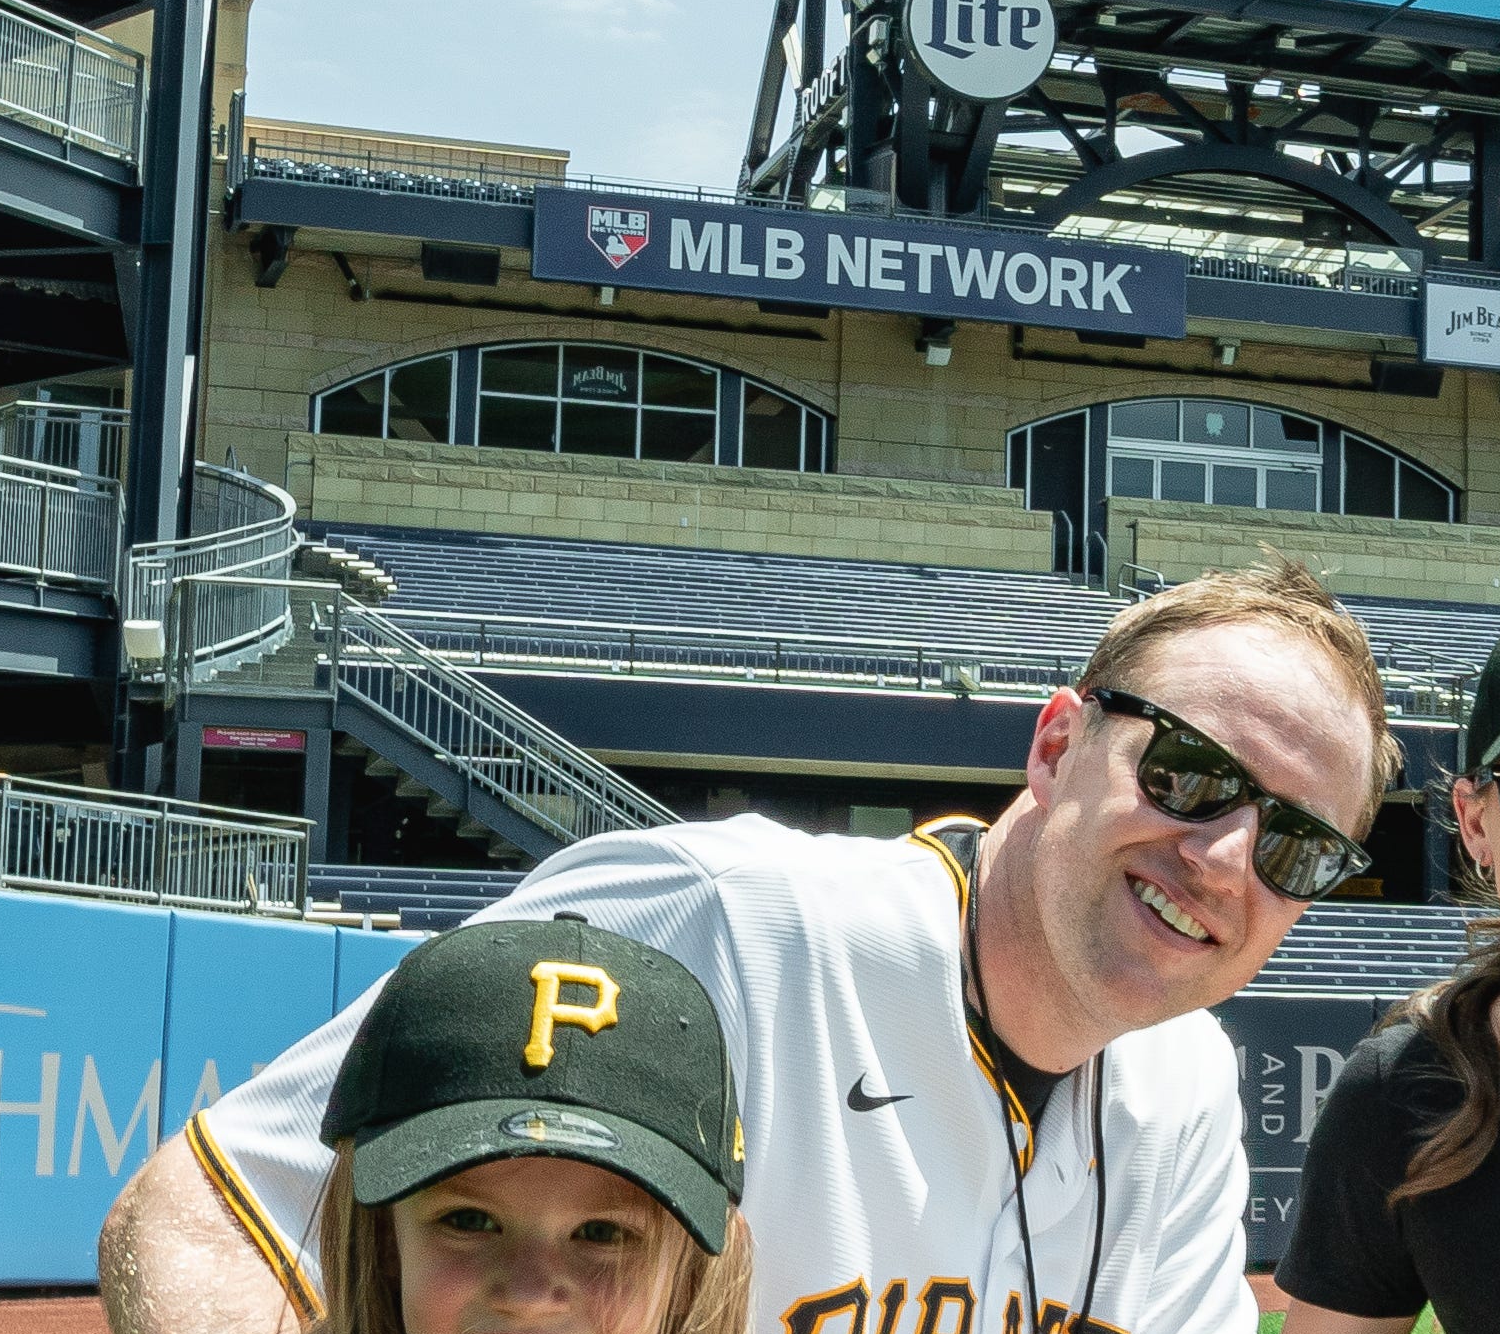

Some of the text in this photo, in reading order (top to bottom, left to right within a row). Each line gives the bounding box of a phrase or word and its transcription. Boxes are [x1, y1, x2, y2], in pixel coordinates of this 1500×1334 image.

[592, 209, 646, 230] MLB
[668, 218, 1134, 315] MLB NETWORK
[1445, 310, 1473, 336] JIM
[524, 960, 621, 1068] P
